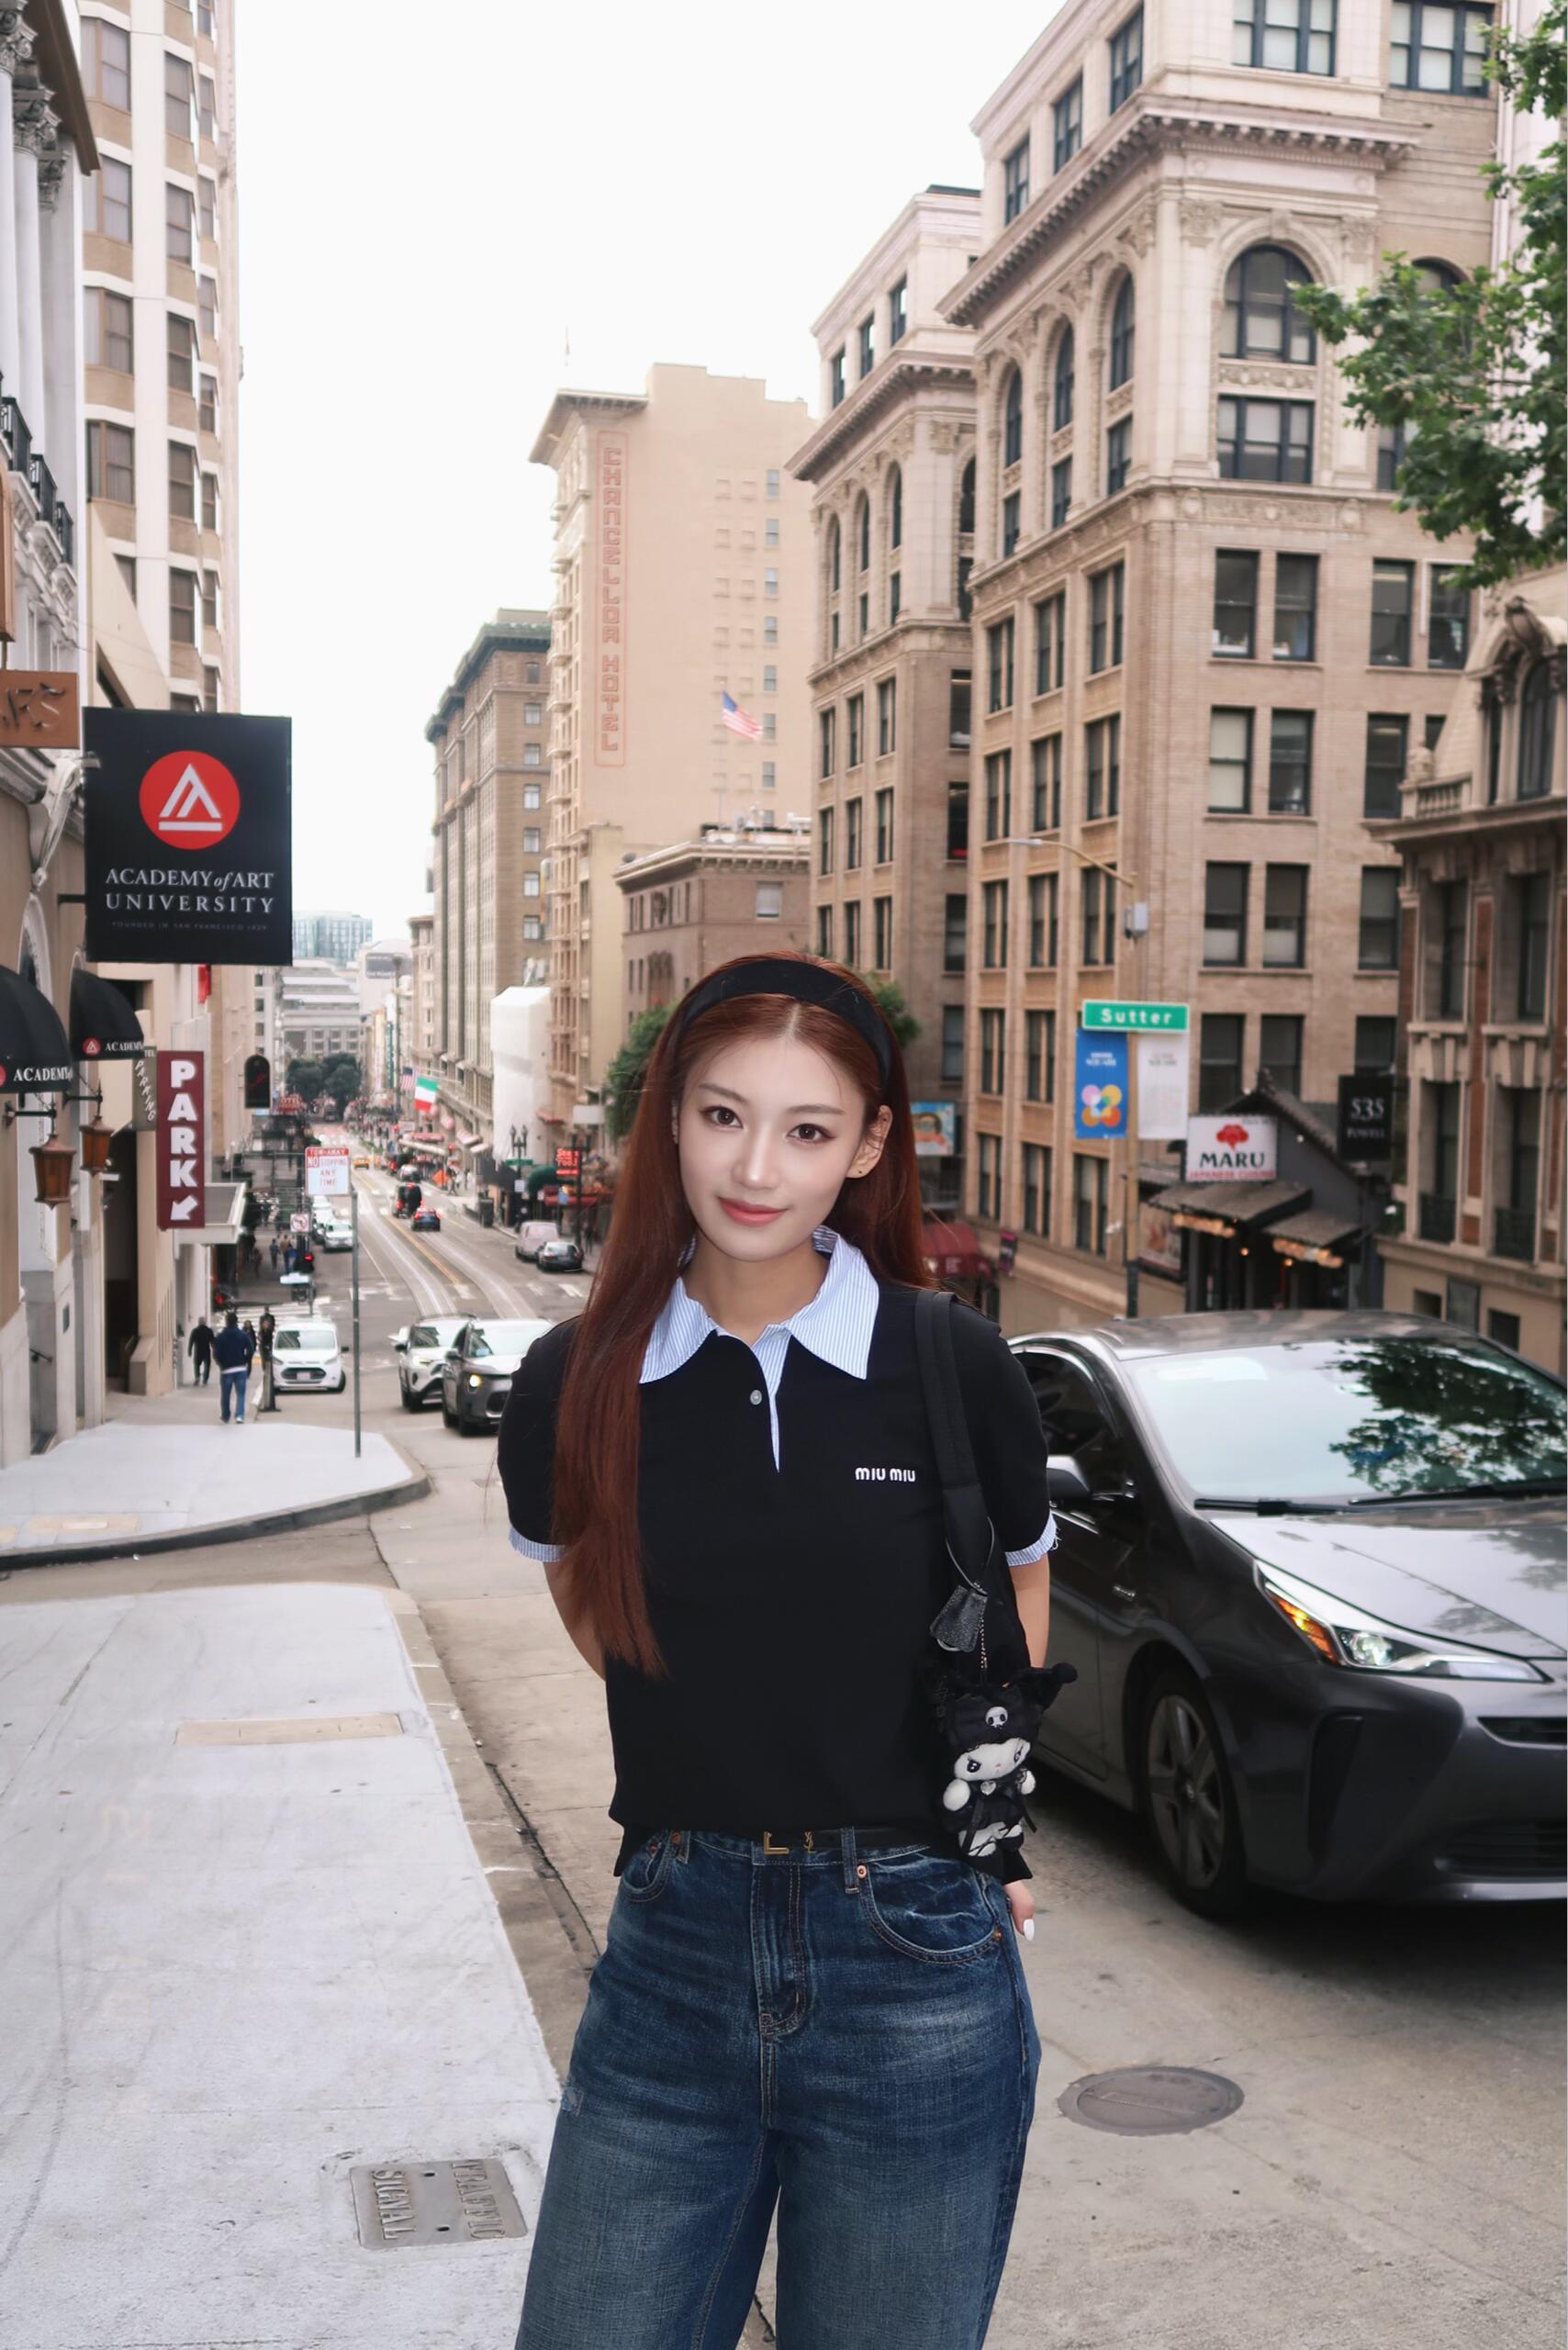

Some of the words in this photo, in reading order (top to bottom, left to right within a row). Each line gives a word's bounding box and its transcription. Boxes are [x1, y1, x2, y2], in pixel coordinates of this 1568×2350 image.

[601, 446, 622, 644] CHANCELLOR
[600, 655, 621, 752] HOTEL
[105, 867, 213, 888] ACADEMY
[213, 872, 232, 892] of
[231, 872, 274, 889] ART
[106, 892, 274, 913] UNIVERSITY
[1101, 1008, 1172, 1024] Sutter
[134, 1060, 157, 1121] PARKING
[1350, 1097, 1384, 1121] 535
[167, 1060, 198, 1188] PARK
[308, 1157, 319, 1167] NO
[1199, 1152, 1265, 1169] MARU
[319, 1169, 337, 1177] ANY
[319, 1178, 338, 1187] TIME
[371, 2169, 417, 2240] SIGNAL
[451, 2159, 506, 2239] TRAFFIC
